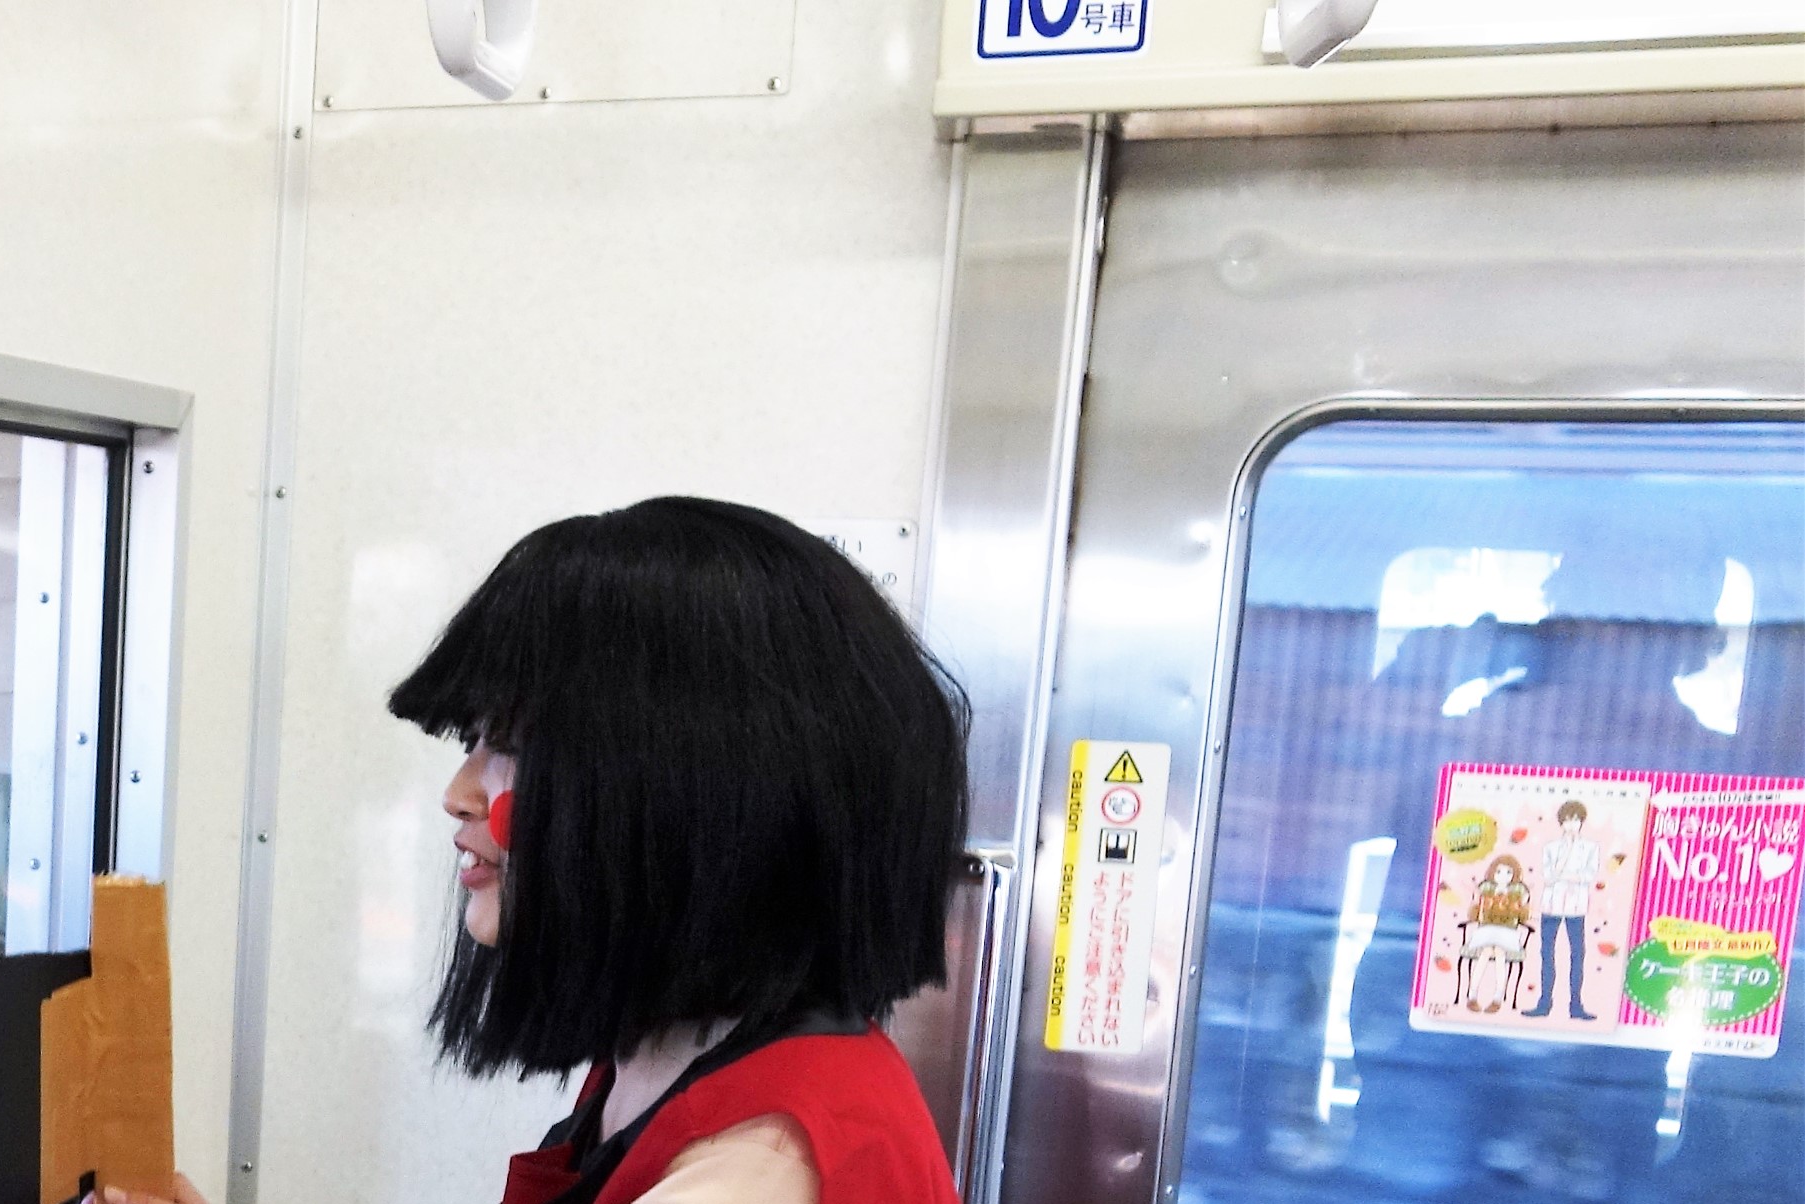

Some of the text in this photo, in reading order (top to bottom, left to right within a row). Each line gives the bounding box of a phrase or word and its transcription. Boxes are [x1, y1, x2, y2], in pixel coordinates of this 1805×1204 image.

[1050, 769, 1083, 1017] caution caution caution
[1652, 811, 1799, 845] 胸きゅん小説
